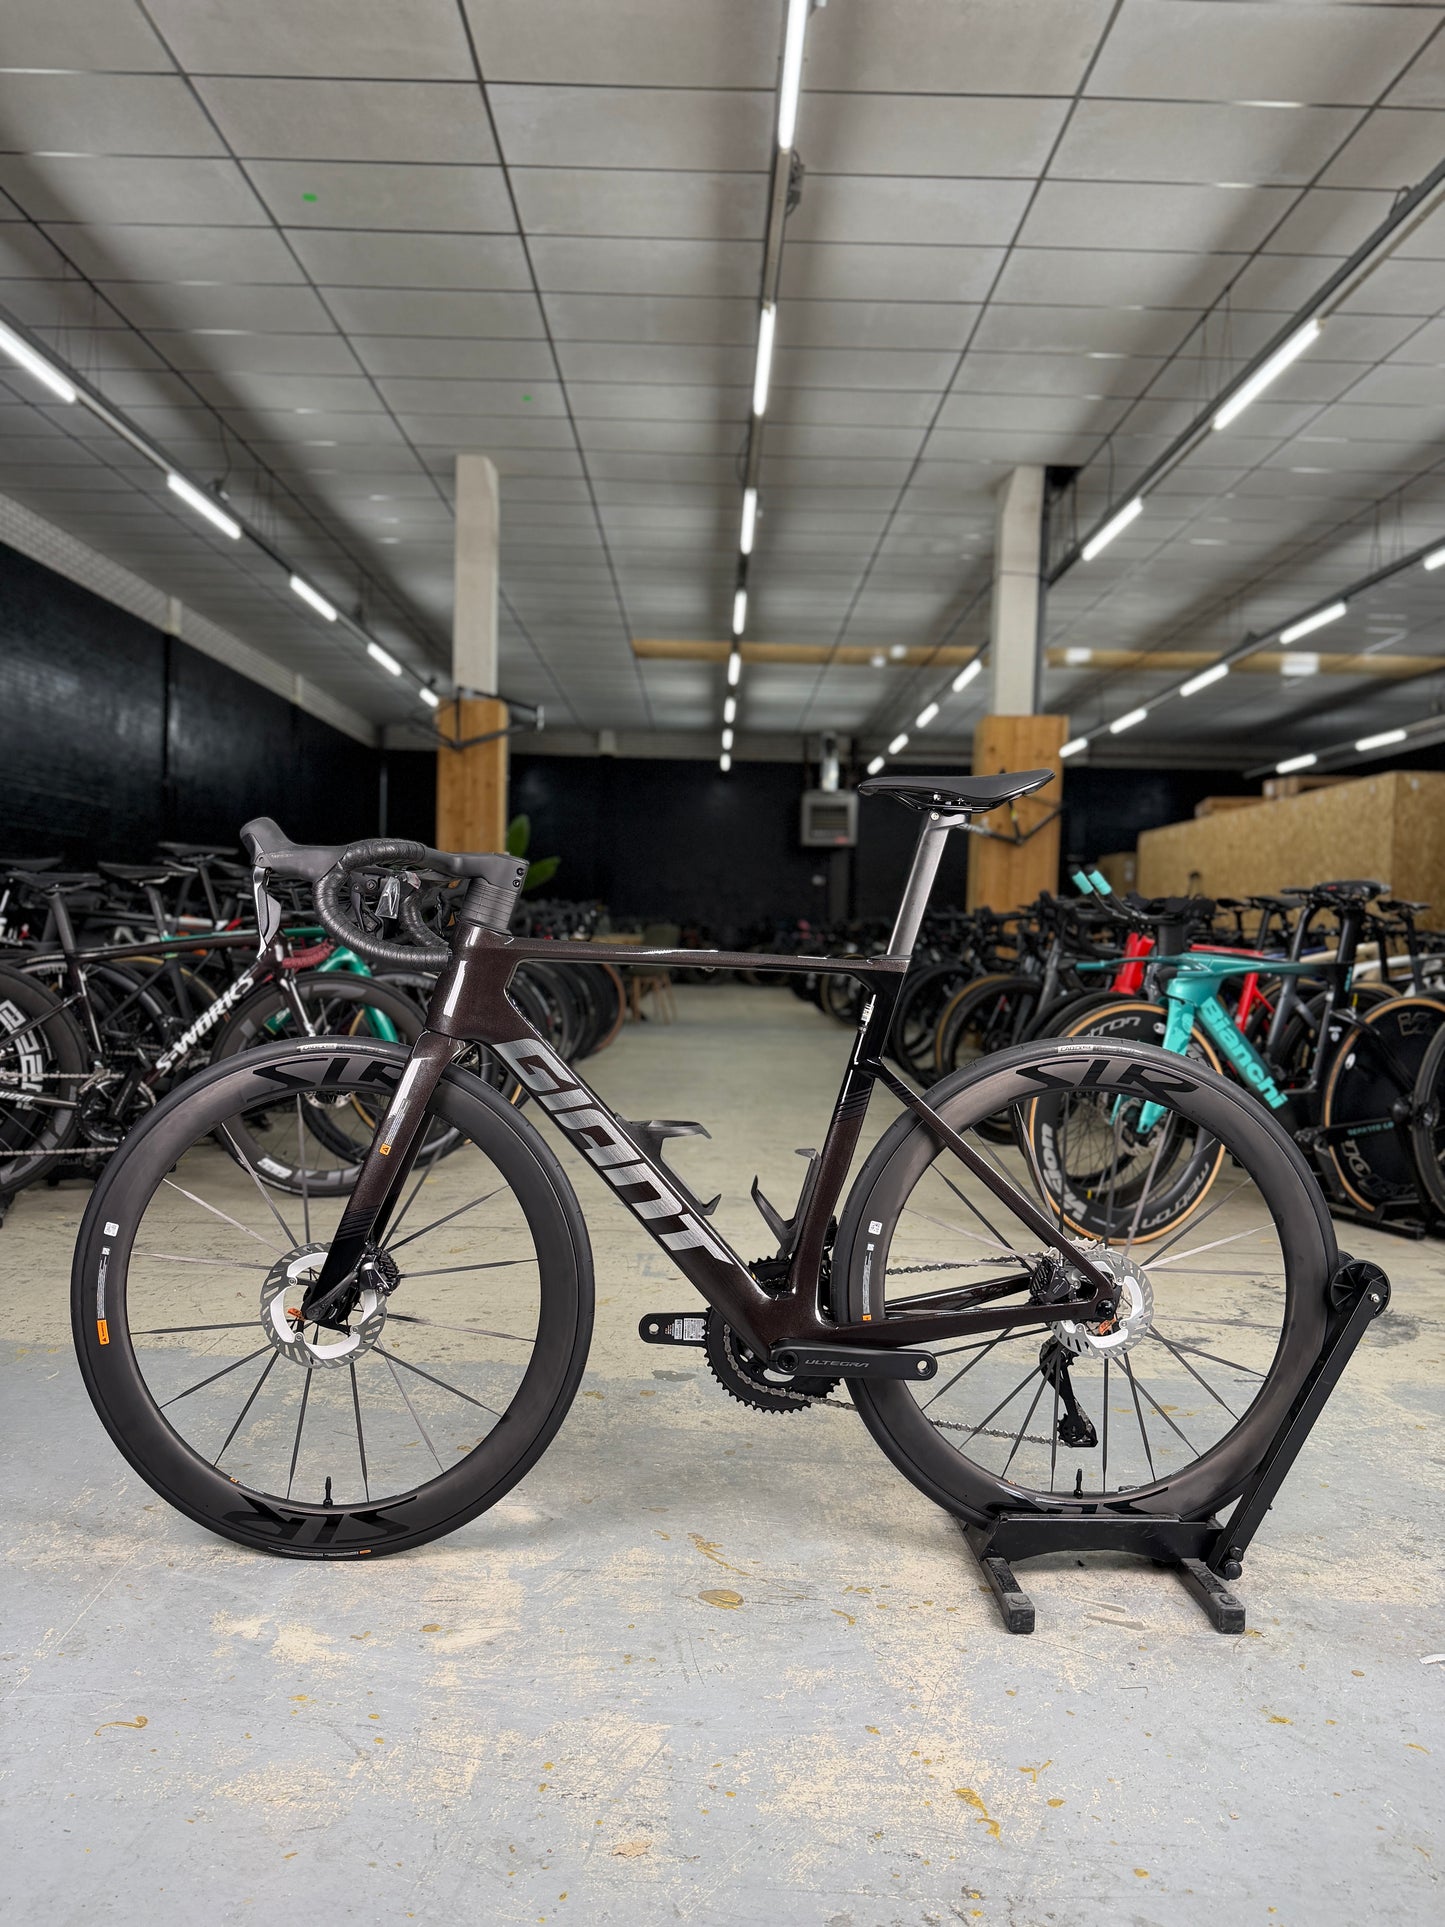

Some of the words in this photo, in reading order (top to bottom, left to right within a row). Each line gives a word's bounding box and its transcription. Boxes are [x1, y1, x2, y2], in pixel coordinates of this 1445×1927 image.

[156, 972, 254, 1077] S-WORKS
[1201, 997, 1288, 1109] Bianchi
[247, 1057, 441, 1104] SLR
[1009, 1059, 1200, 1111] SLR
[492, 1038, 735, 1265] GIANT
[1141, 1162, 1210, 1229] metron
[805, 1359, 870, 1368] ULTEGRA
[222, 1492, 417, 1544] SLR
